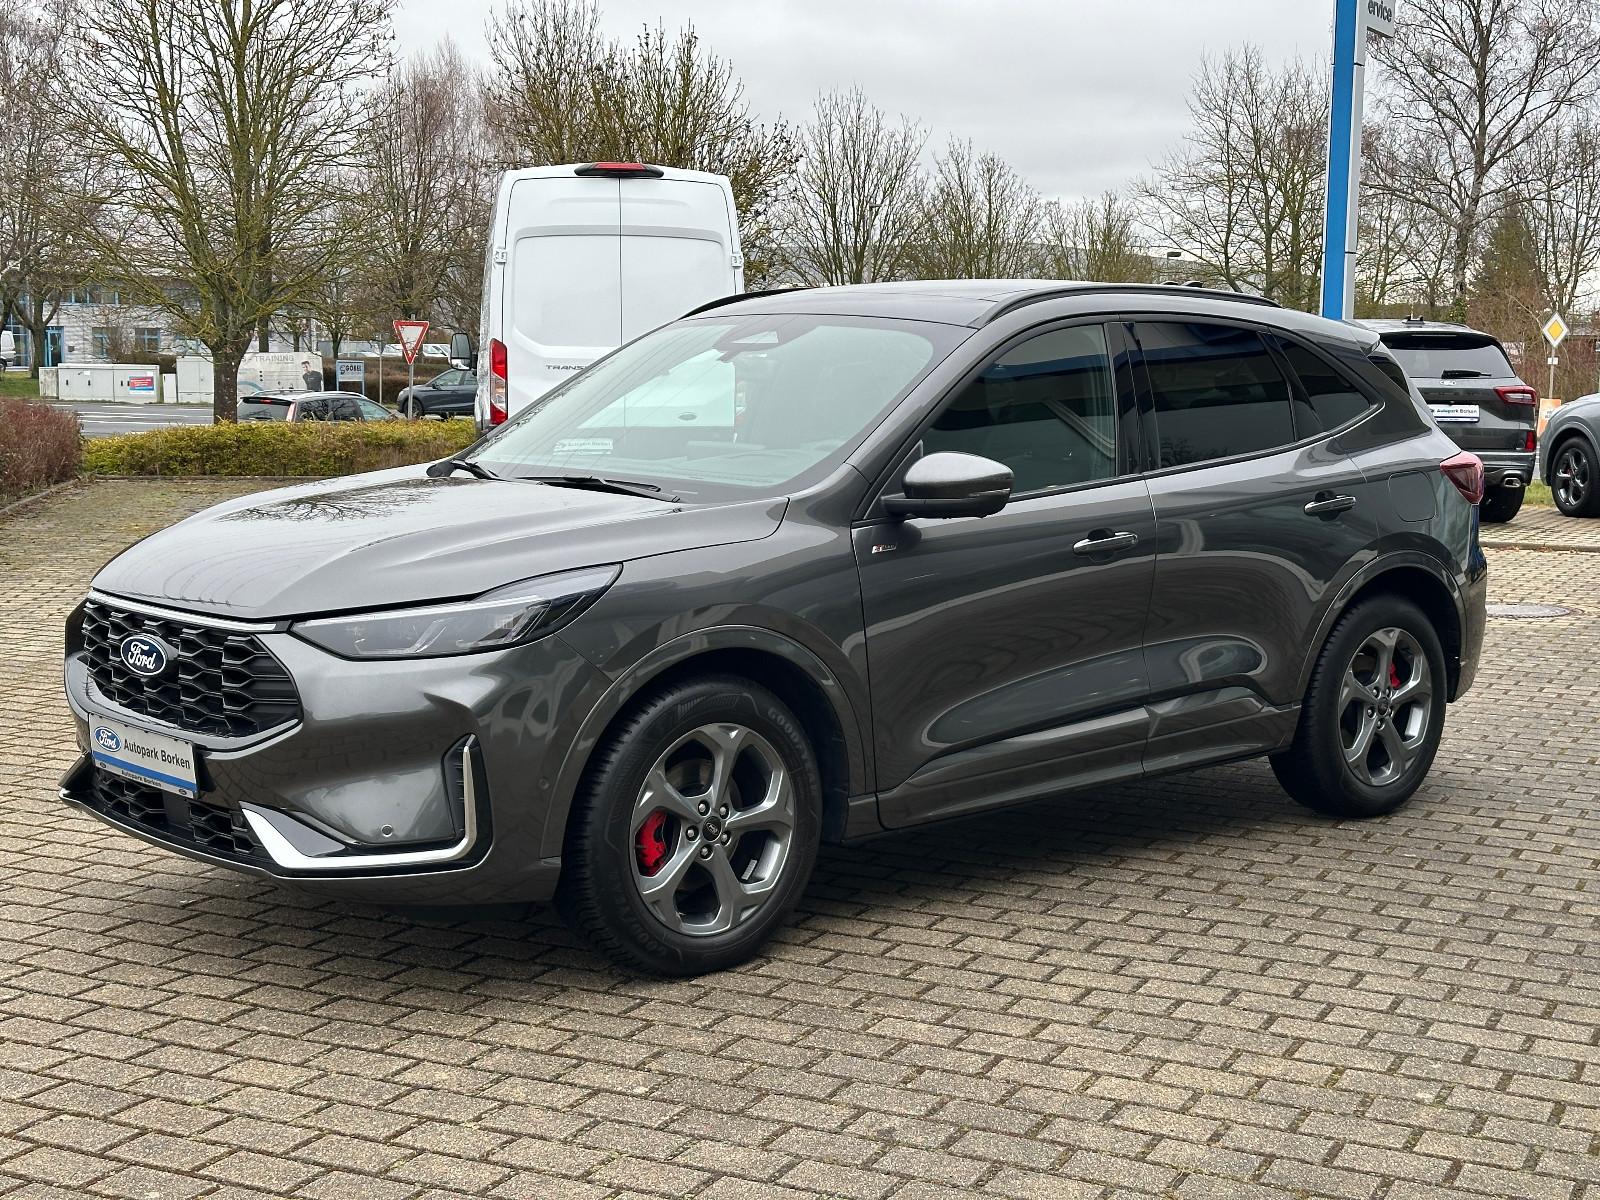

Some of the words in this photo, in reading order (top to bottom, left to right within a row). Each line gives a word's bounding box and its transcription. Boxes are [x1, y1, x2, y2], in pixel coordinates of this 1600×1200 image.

[128, 641, 156, 669] Ford
[124, 738, 159, 760] Autopark
[161, 750, 191, 769] Borken
[121, 769, 142, 781] Autopark
[143, 777, 162, 787] Borken
